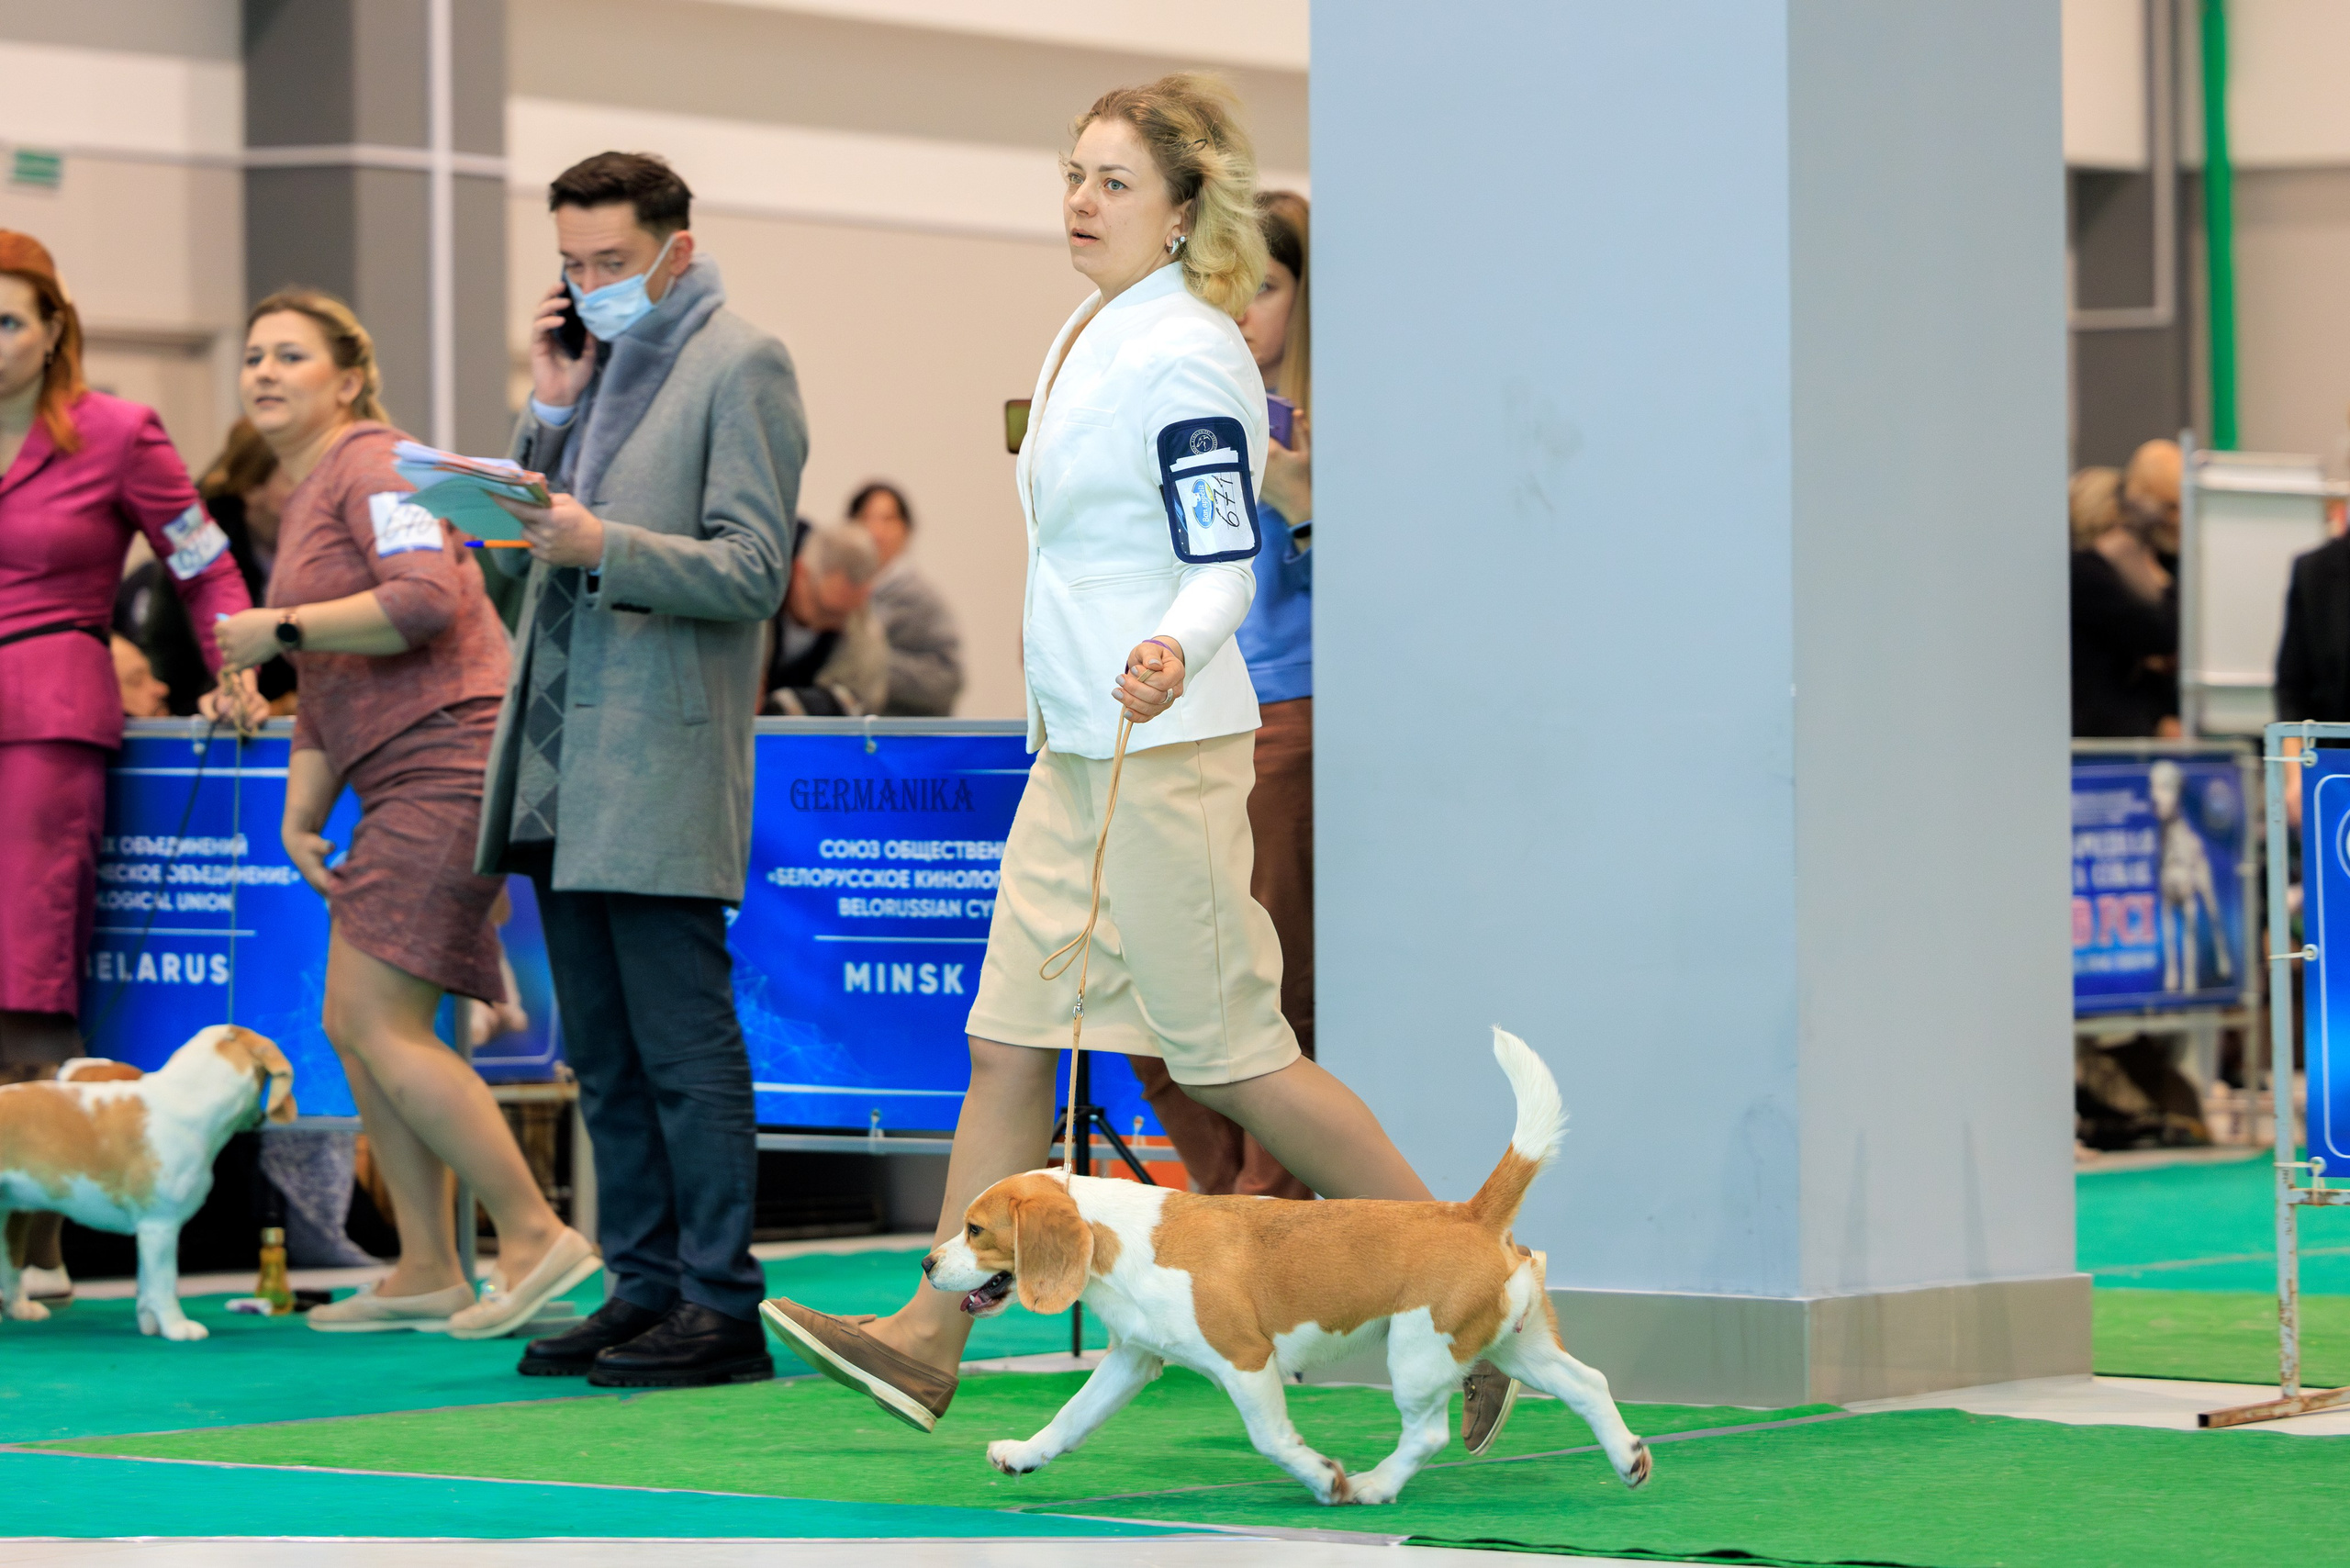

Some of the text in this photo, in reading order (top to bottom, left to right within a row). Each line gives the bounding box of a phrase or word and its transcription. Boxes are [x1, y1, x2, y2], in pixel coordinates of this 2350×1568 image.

[819, 839, 881, 859] СОЮЗ
[838, 897, 996, 919] BELORUSSIAN CY
[844, 962, 964, 995] MINSK
